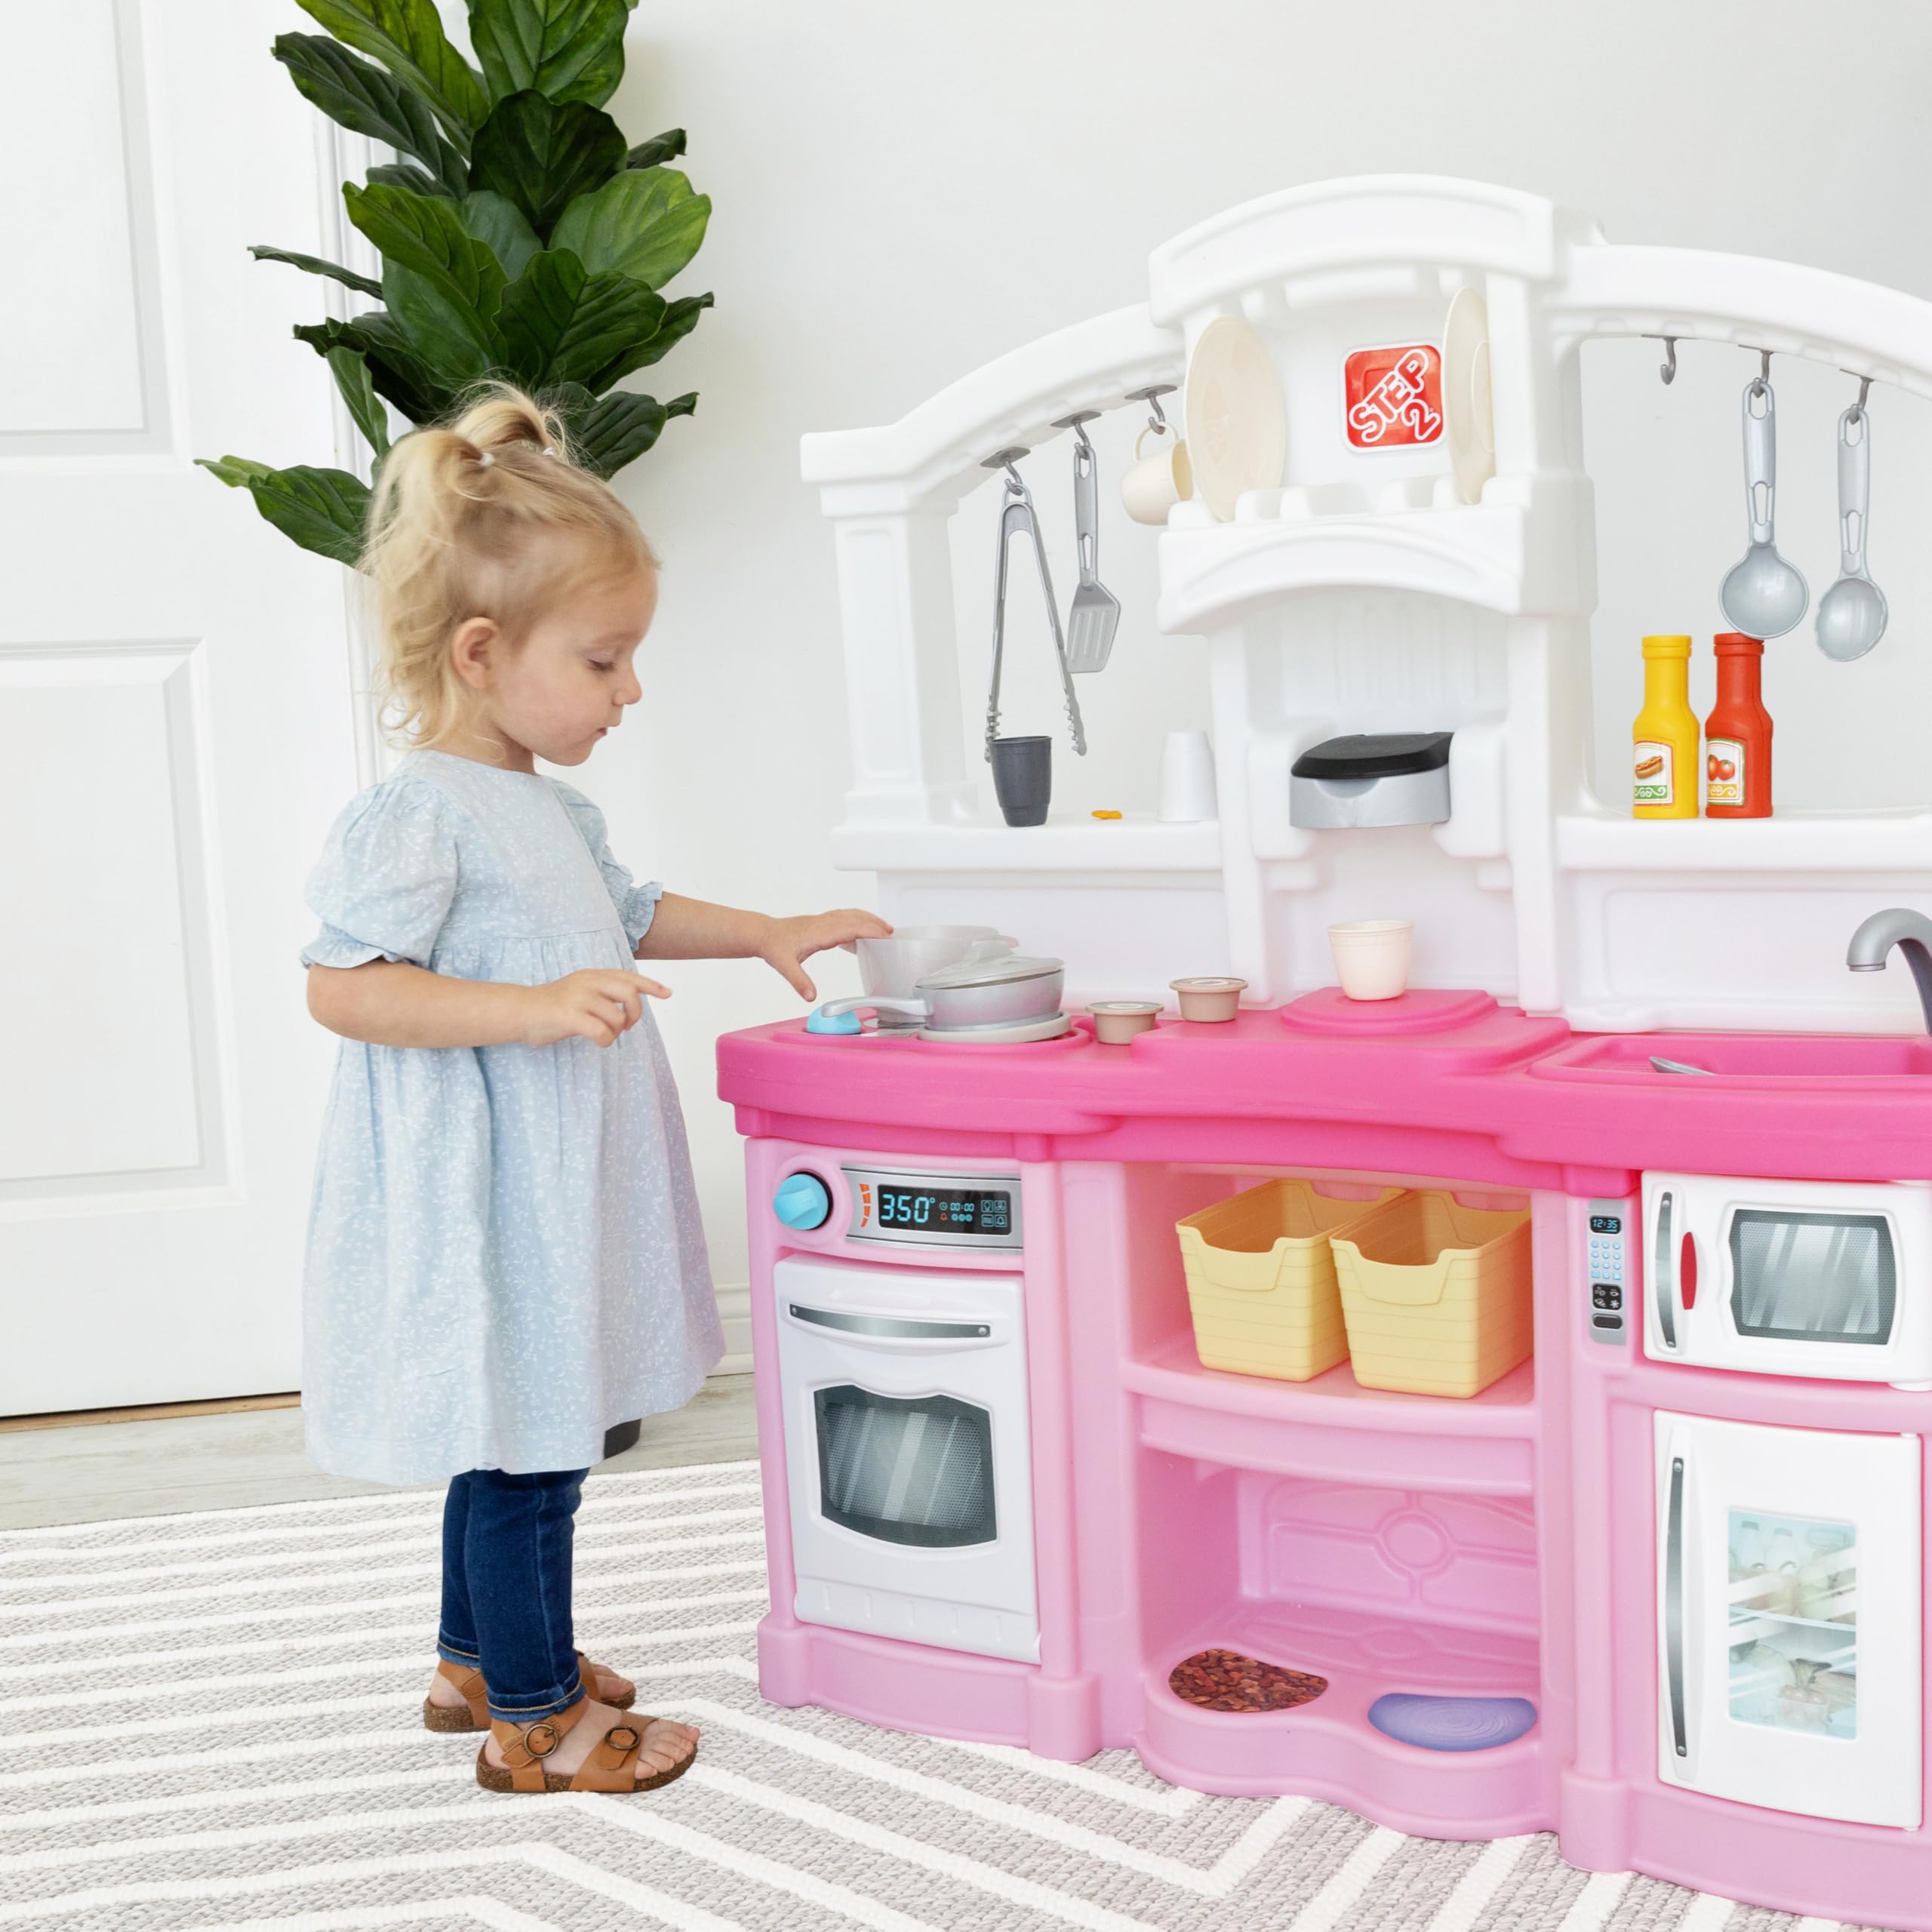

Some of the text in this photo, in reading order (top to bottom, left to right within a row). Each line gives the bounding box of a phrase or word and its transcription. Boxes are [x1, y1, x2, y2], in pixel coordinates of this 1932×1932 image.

[1349, 349, 1429, 443] STEP
[1401, 399, 1441, 440] 2
[1593, 1219, 1618, 1229] 12:35
